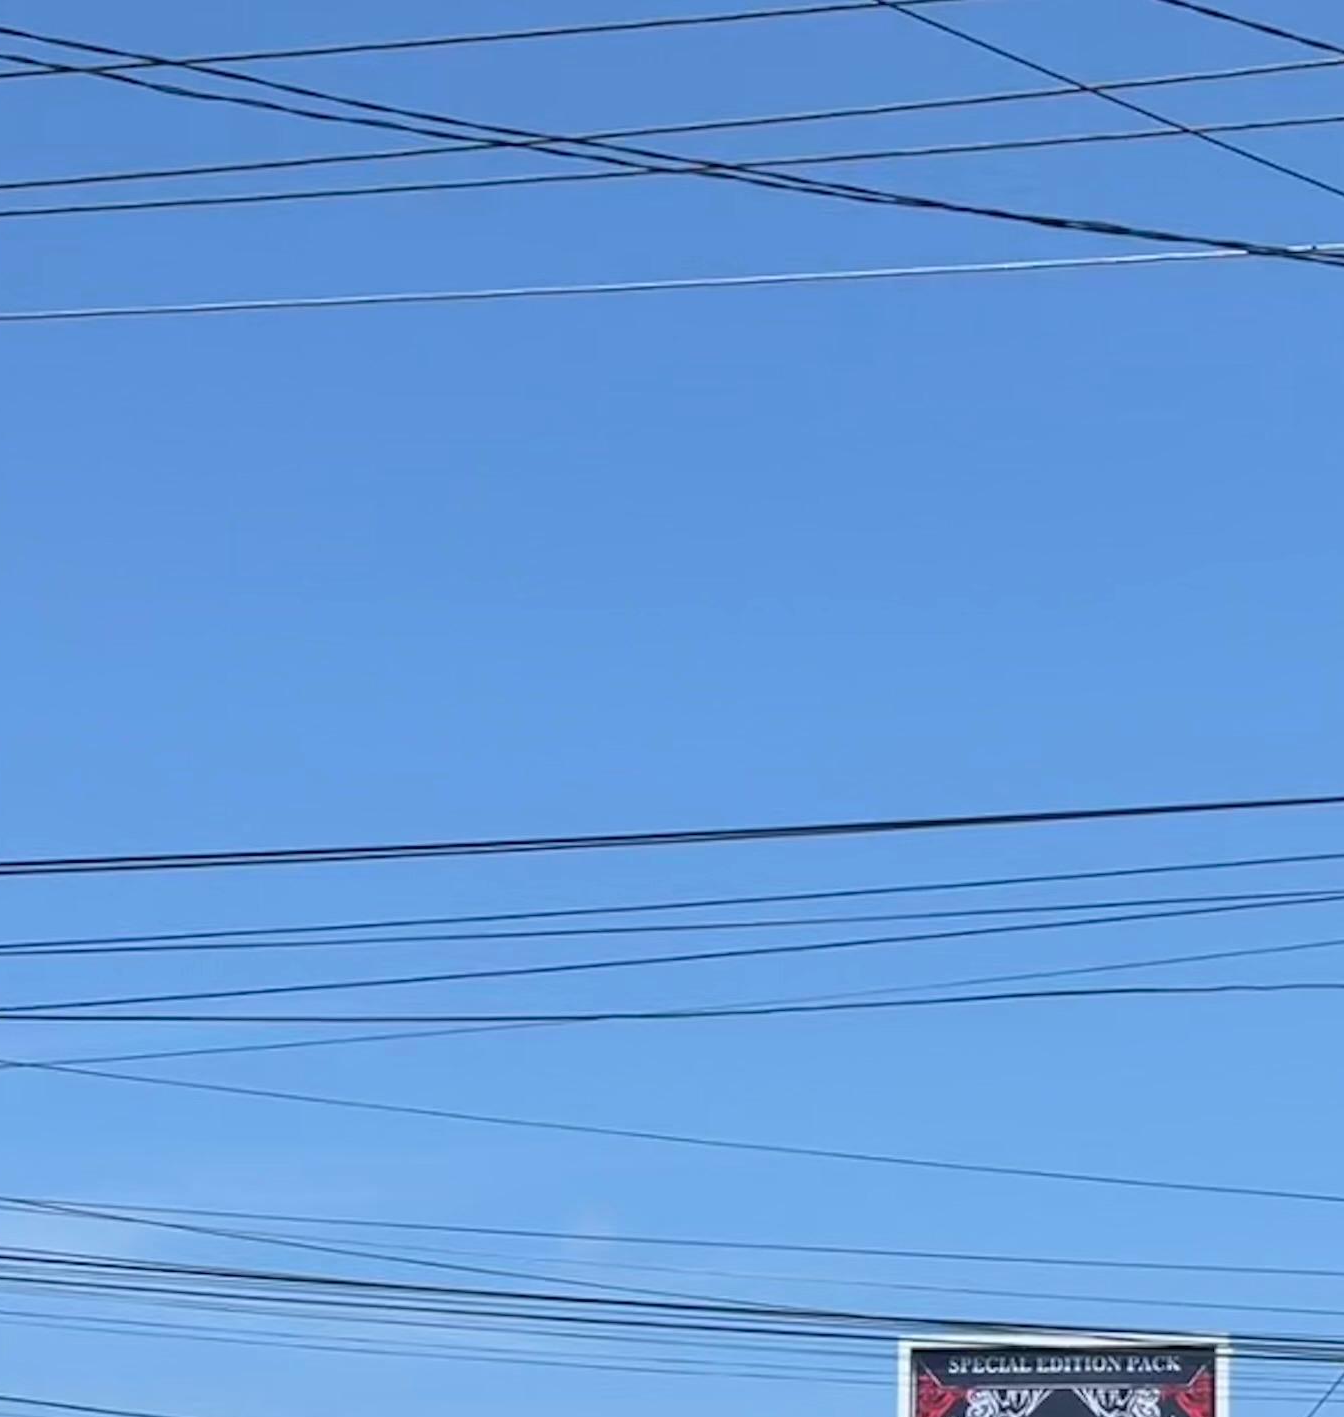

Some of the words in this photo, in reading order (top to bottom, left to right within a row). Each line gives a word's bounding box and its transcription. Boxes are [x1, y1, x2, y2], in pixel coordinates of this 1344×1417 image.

[948, 1355, 1032, 1374] SPECIAL
[1036, 1355, 1121, 1373] EDITION
[1126, 1354, 1182, 1373] PACK
